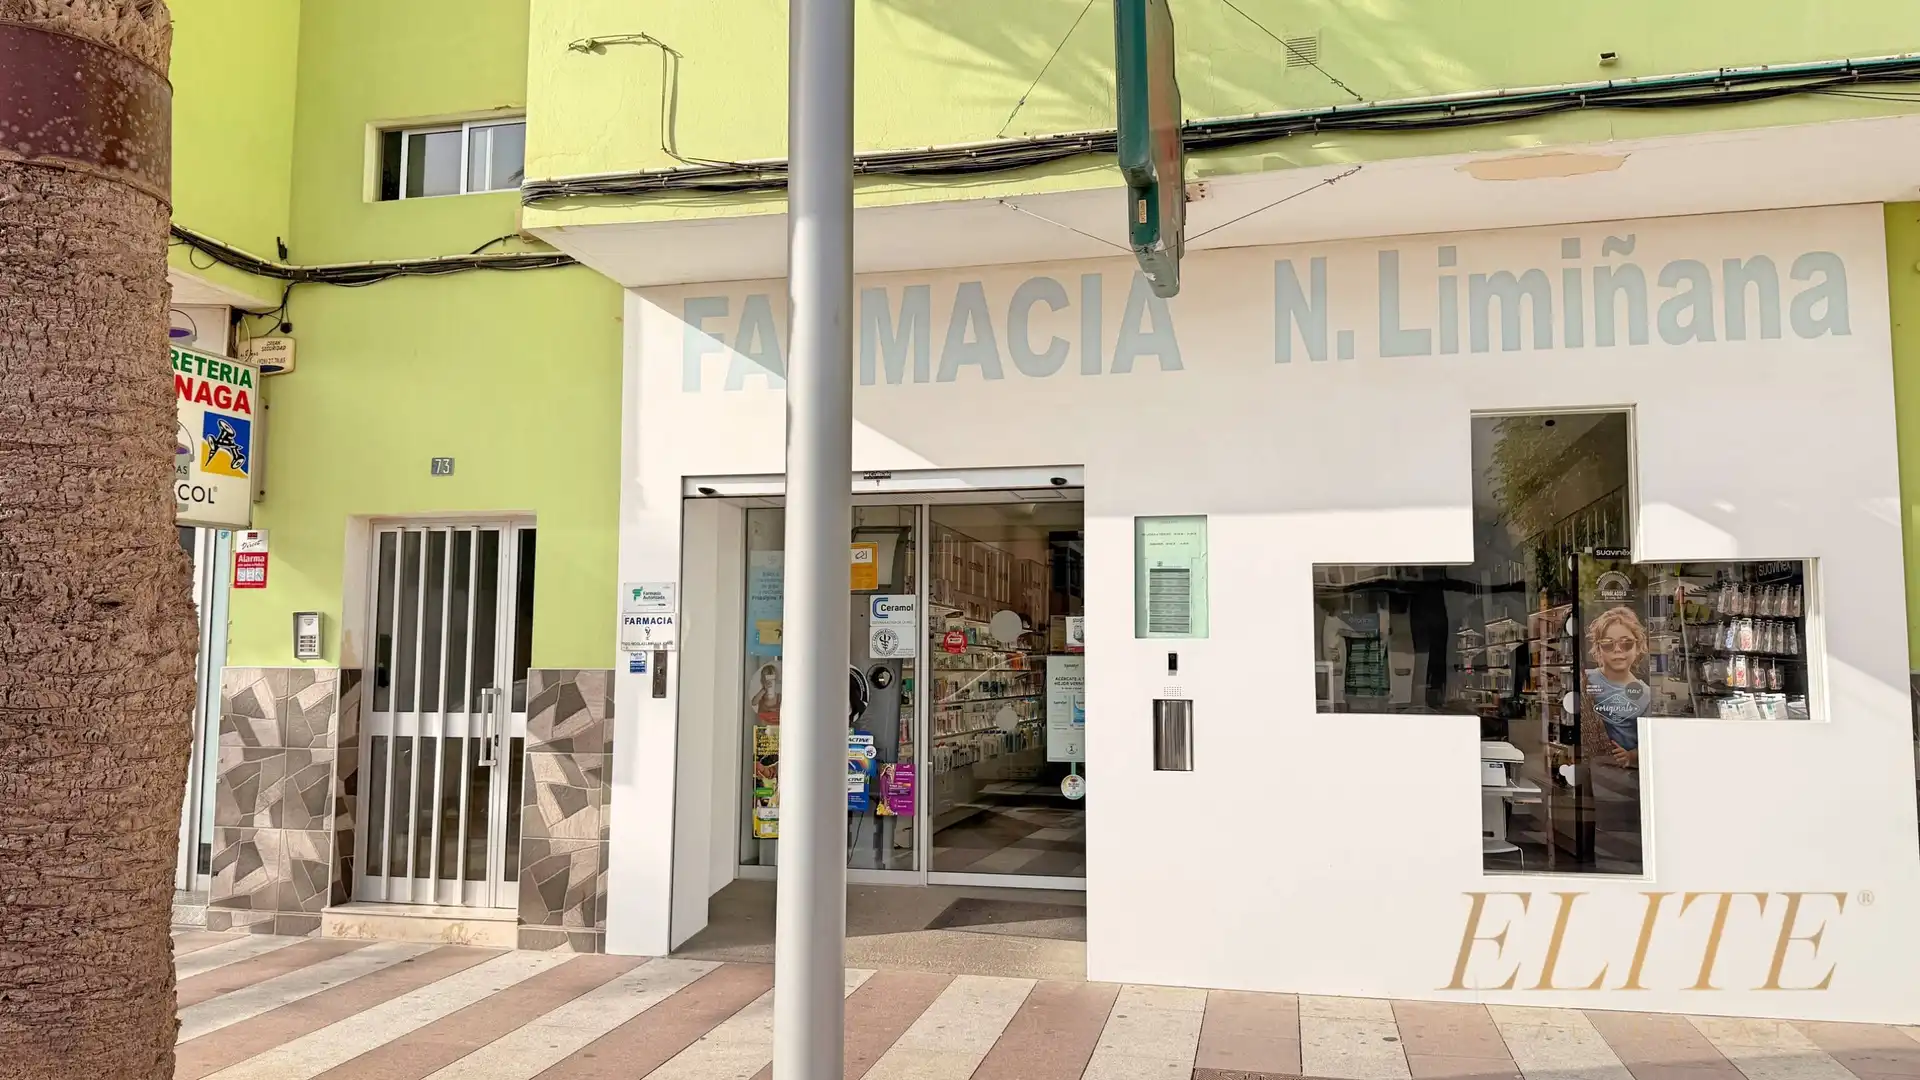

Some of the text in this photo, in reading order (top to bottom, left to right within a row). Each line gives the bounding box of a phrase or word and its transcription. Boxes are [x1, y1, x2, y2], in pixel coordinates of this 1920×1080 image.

[682, 233, 1852, 392] FAMACIA N. Limiñana
[435, 458, 450, 474] 73
[238, 554, 265, 563] Alarma
[881, 603, 914, 612] Ceramol
[624, 617, 673, 625] FARMACIA
